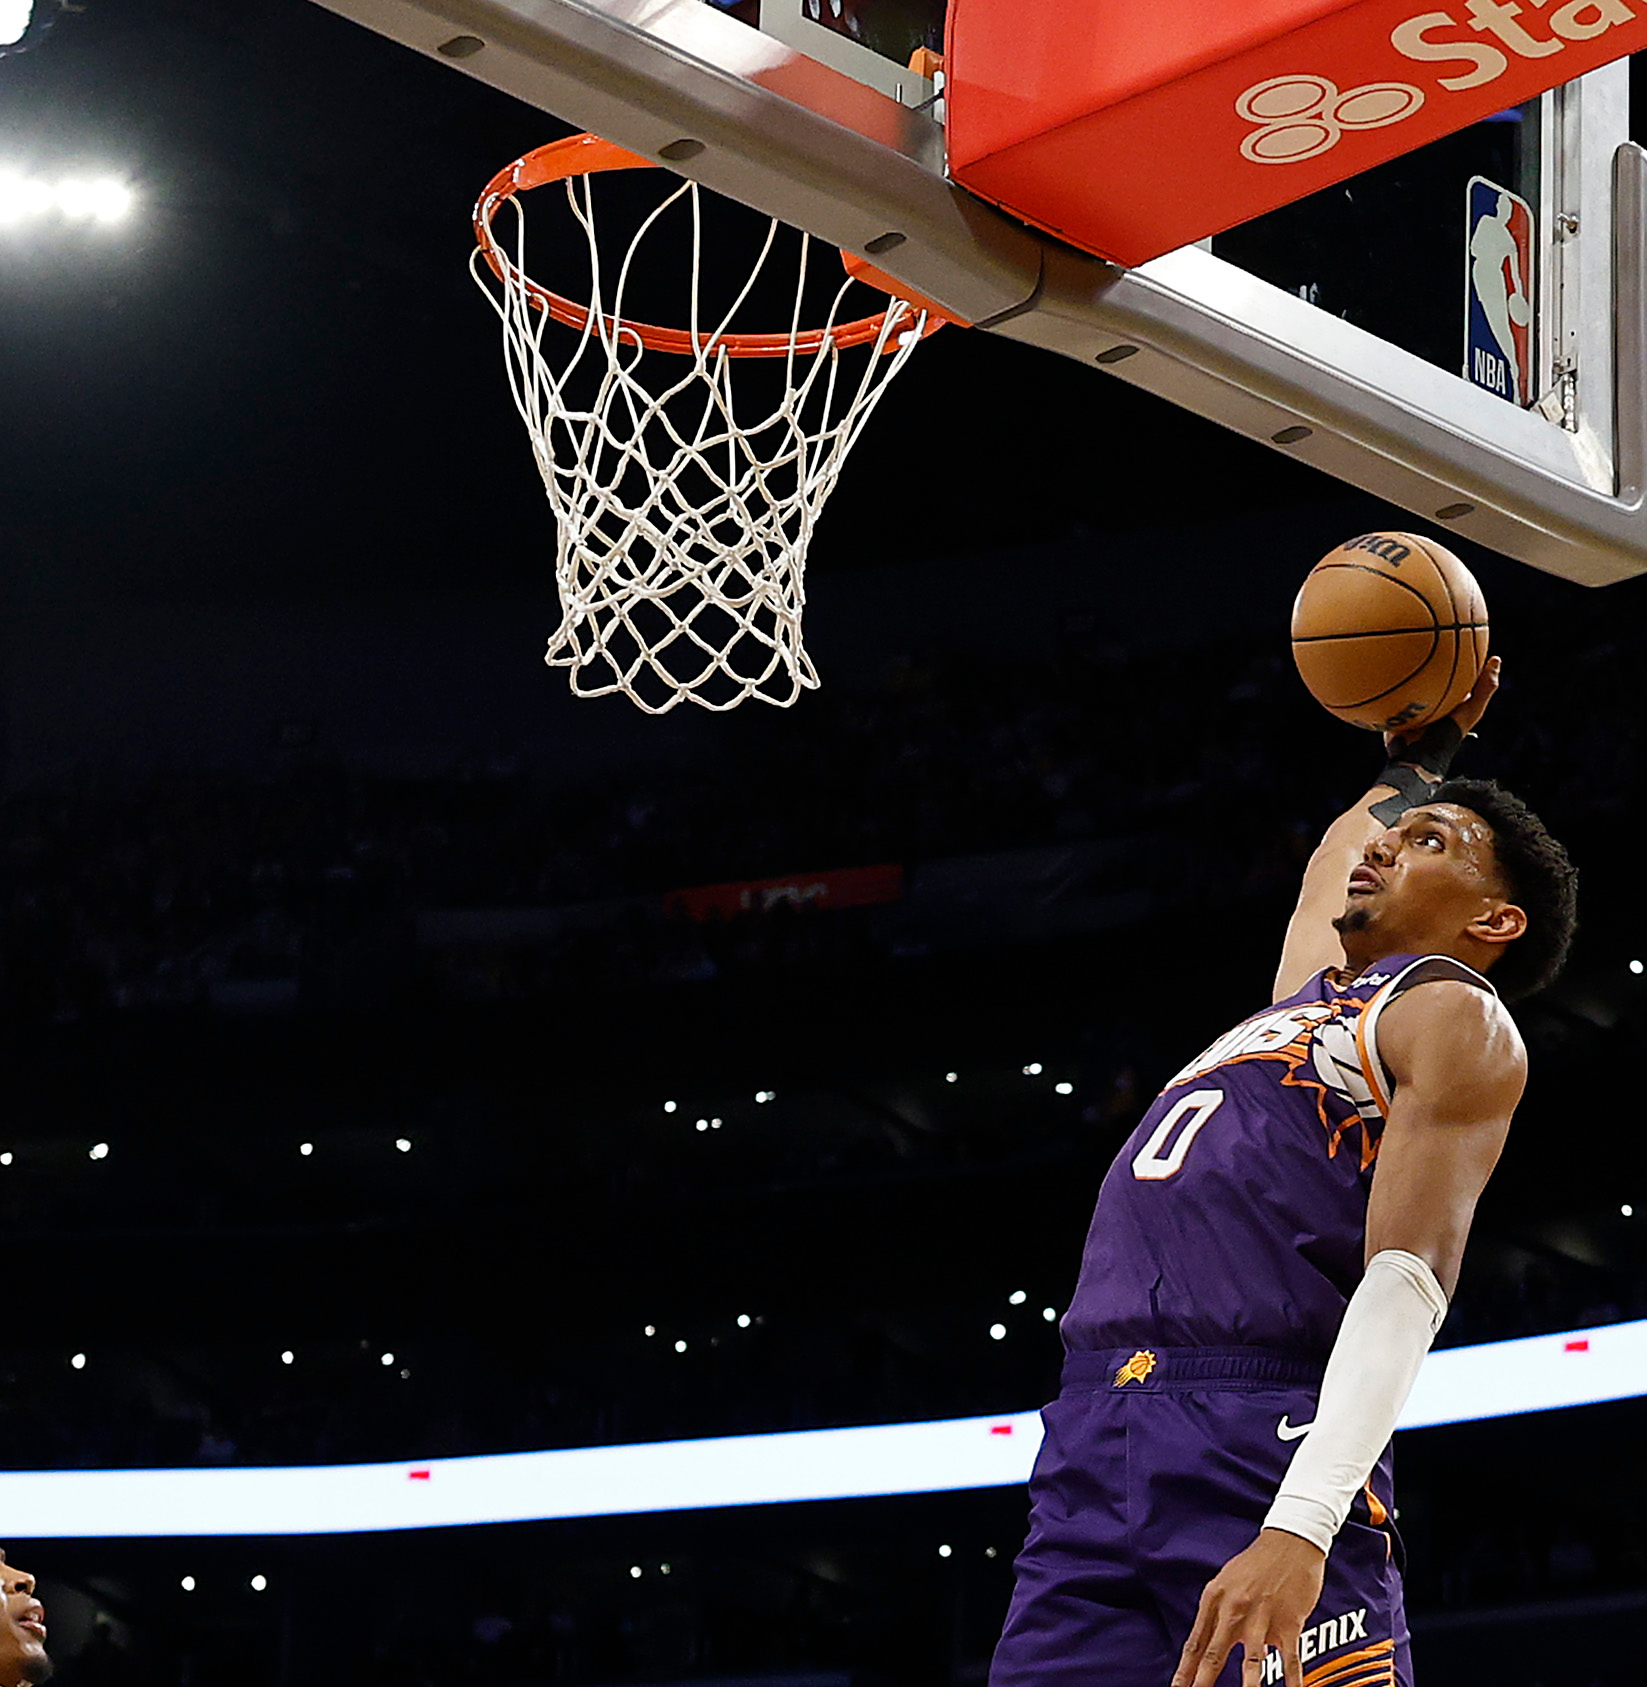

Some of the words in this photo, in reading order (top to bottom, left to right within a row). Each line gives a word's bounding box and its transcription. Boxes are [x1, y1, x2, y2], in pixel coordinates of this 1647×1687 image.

[1474, 346, 1507, 395] NBA
[1131, 1089, 1224, 1180] 0
[1261, 1607, 1369, 1686] HENIX
